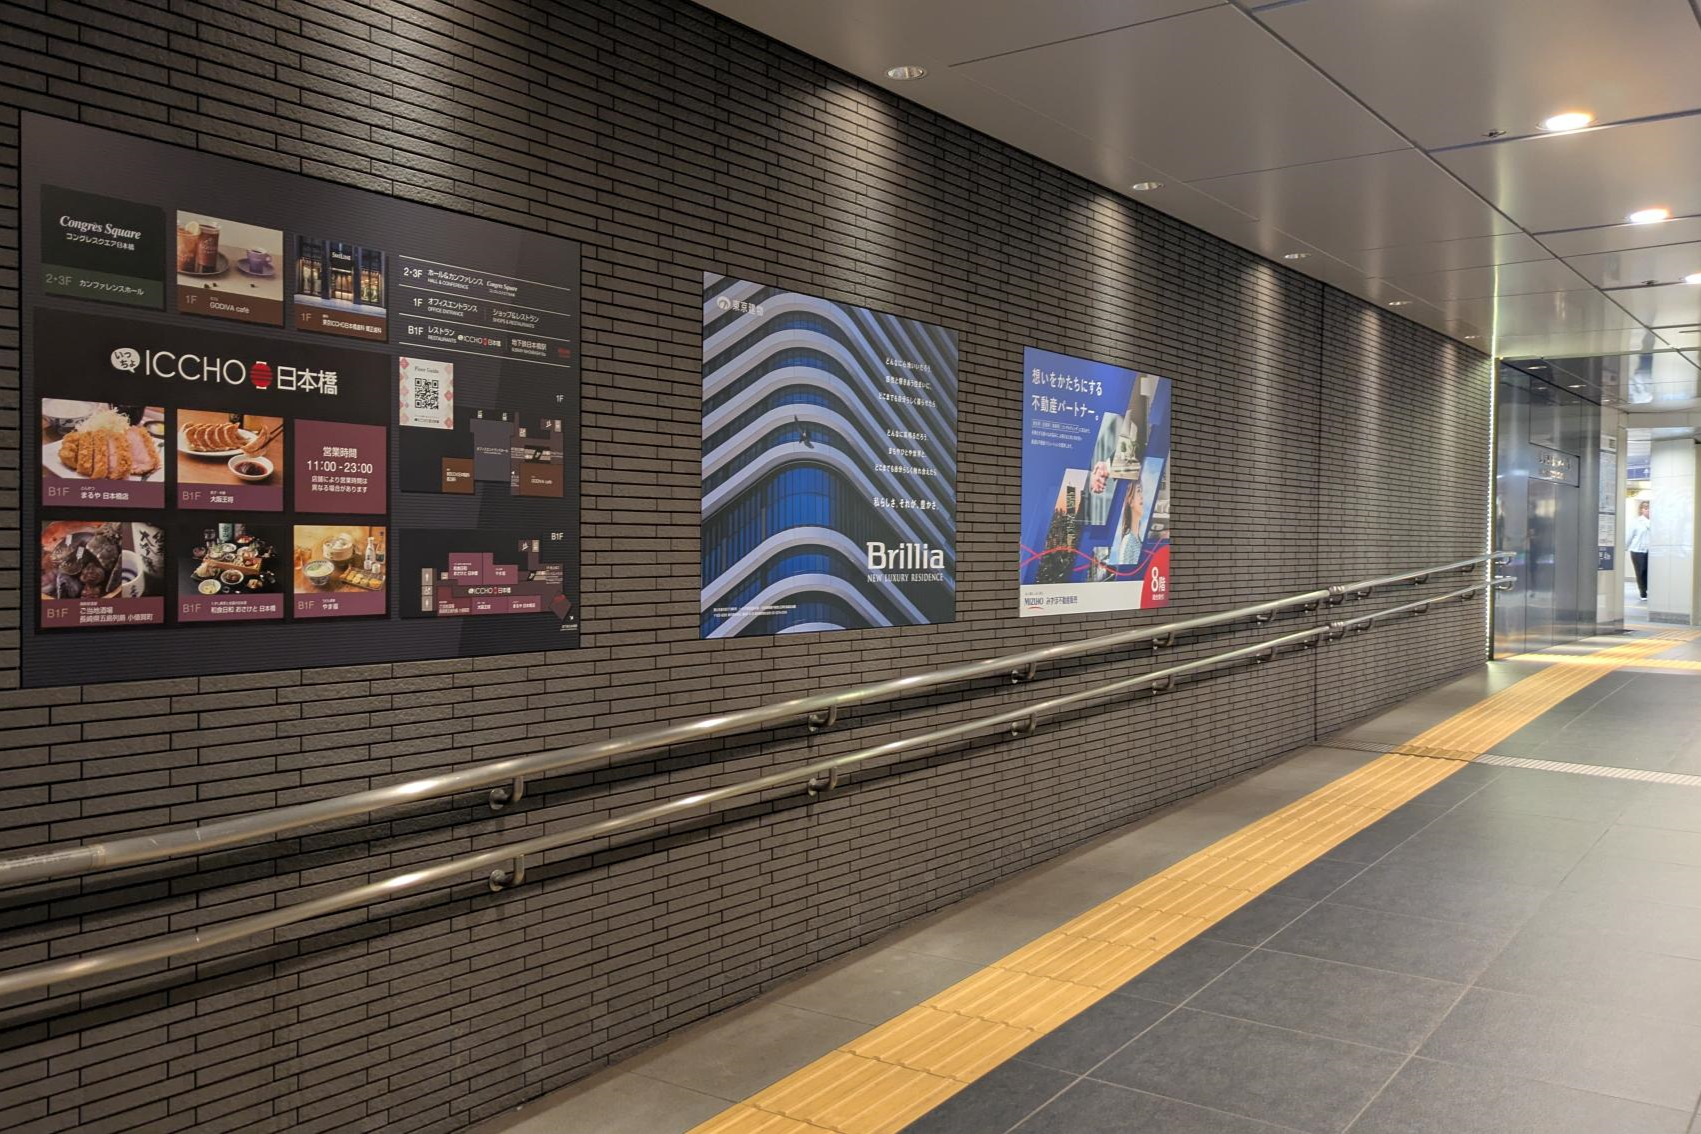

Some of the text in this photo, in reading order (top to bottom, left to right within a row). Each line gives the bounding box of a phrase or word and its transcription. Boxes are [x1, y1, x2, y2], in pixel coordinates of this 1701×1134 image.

[60, 215, 142, 240] Congrès Square
[79, 280, 144, 296] カンファレンスホール
[186, 295, 198, 304] 1F
[413, 298, 423, 307] 1F
[210, 302, 234, 312] GODIVA
[428, 298, 478, 312] オフィスエントランス
[732, 300, 764, 316] 東京建物
[301, 312, 312, 322] 1F
[408, 325, 424, 335] B1F
[428, 326, 455, 336] レストラン
[145, 349, 338, 395] ICCHO 日本橋
[1032, 367, 1103, 396] 想いをかたちにする
[556, 394, 564, 402] 1F
[1032, 394, 1099, 421] 不動産パートナー。
[323, 446, 357, 458] 営業時間
[48, 486, 70, 497] B1F
[80, 492, 101, 500] まるや
[182, 490, 201, 500] B1F
[551, 532, 564, 541] B1F
[866, 541, 944, 570] Brillia
[867, 573, 944, 583] NEW LUXURY RESIDENCE
[298, 601, 315, 610] B1F
[1024, 597, 1043, 605] MIZUHO
[47, 608, 69, 618] B1F
[183, 603, 202, 613] B1F
